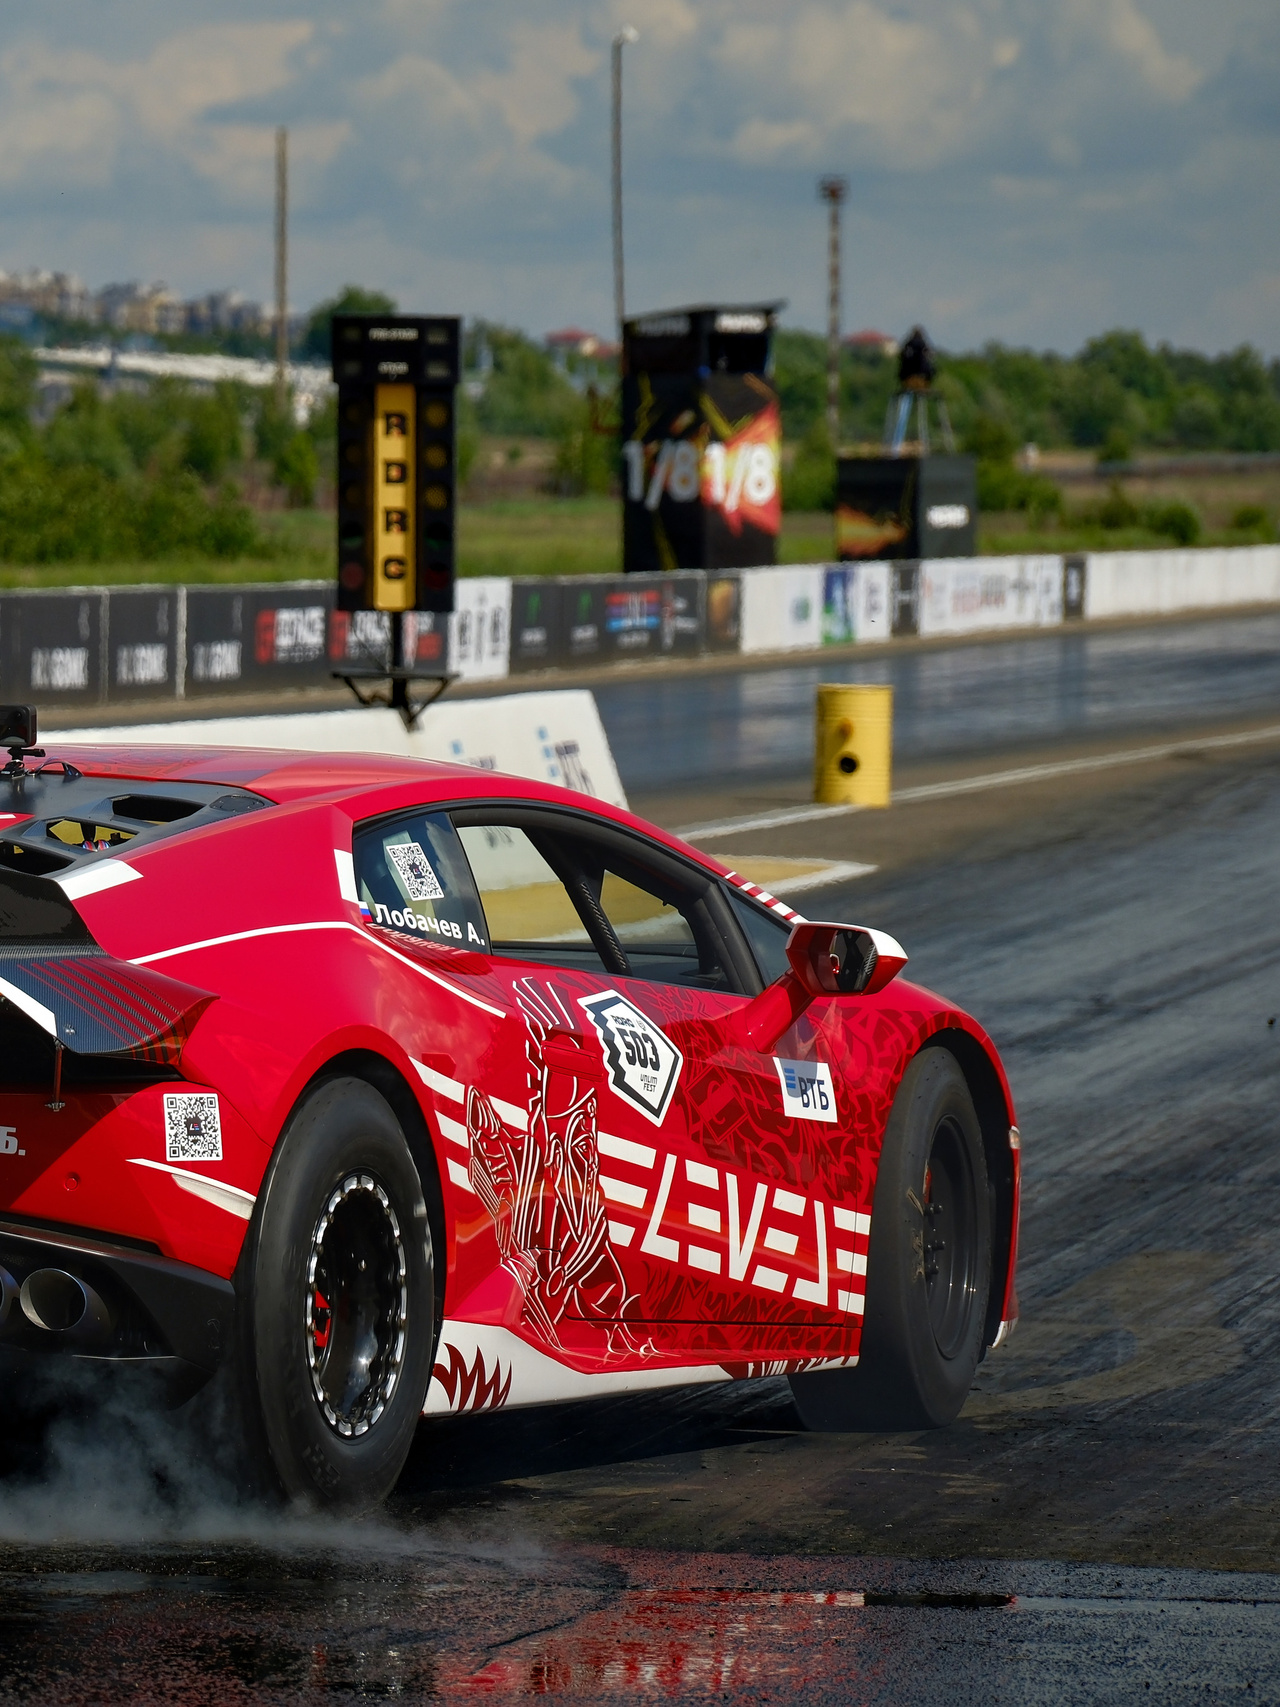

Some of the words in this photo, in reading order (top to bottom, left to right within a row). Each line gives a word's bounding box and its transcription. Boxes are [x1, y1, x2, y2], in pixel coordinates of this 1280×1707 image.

[705, 440, 777, 513] 1/8
[374, 903, 463, 939] Лобачев
[467, 921, 486, 946] А.
[616, 1027, 661, 1072] 503
[643, 1083, 657, 1093] FEST
[797, 1076, 829, 1111] ВТБ
